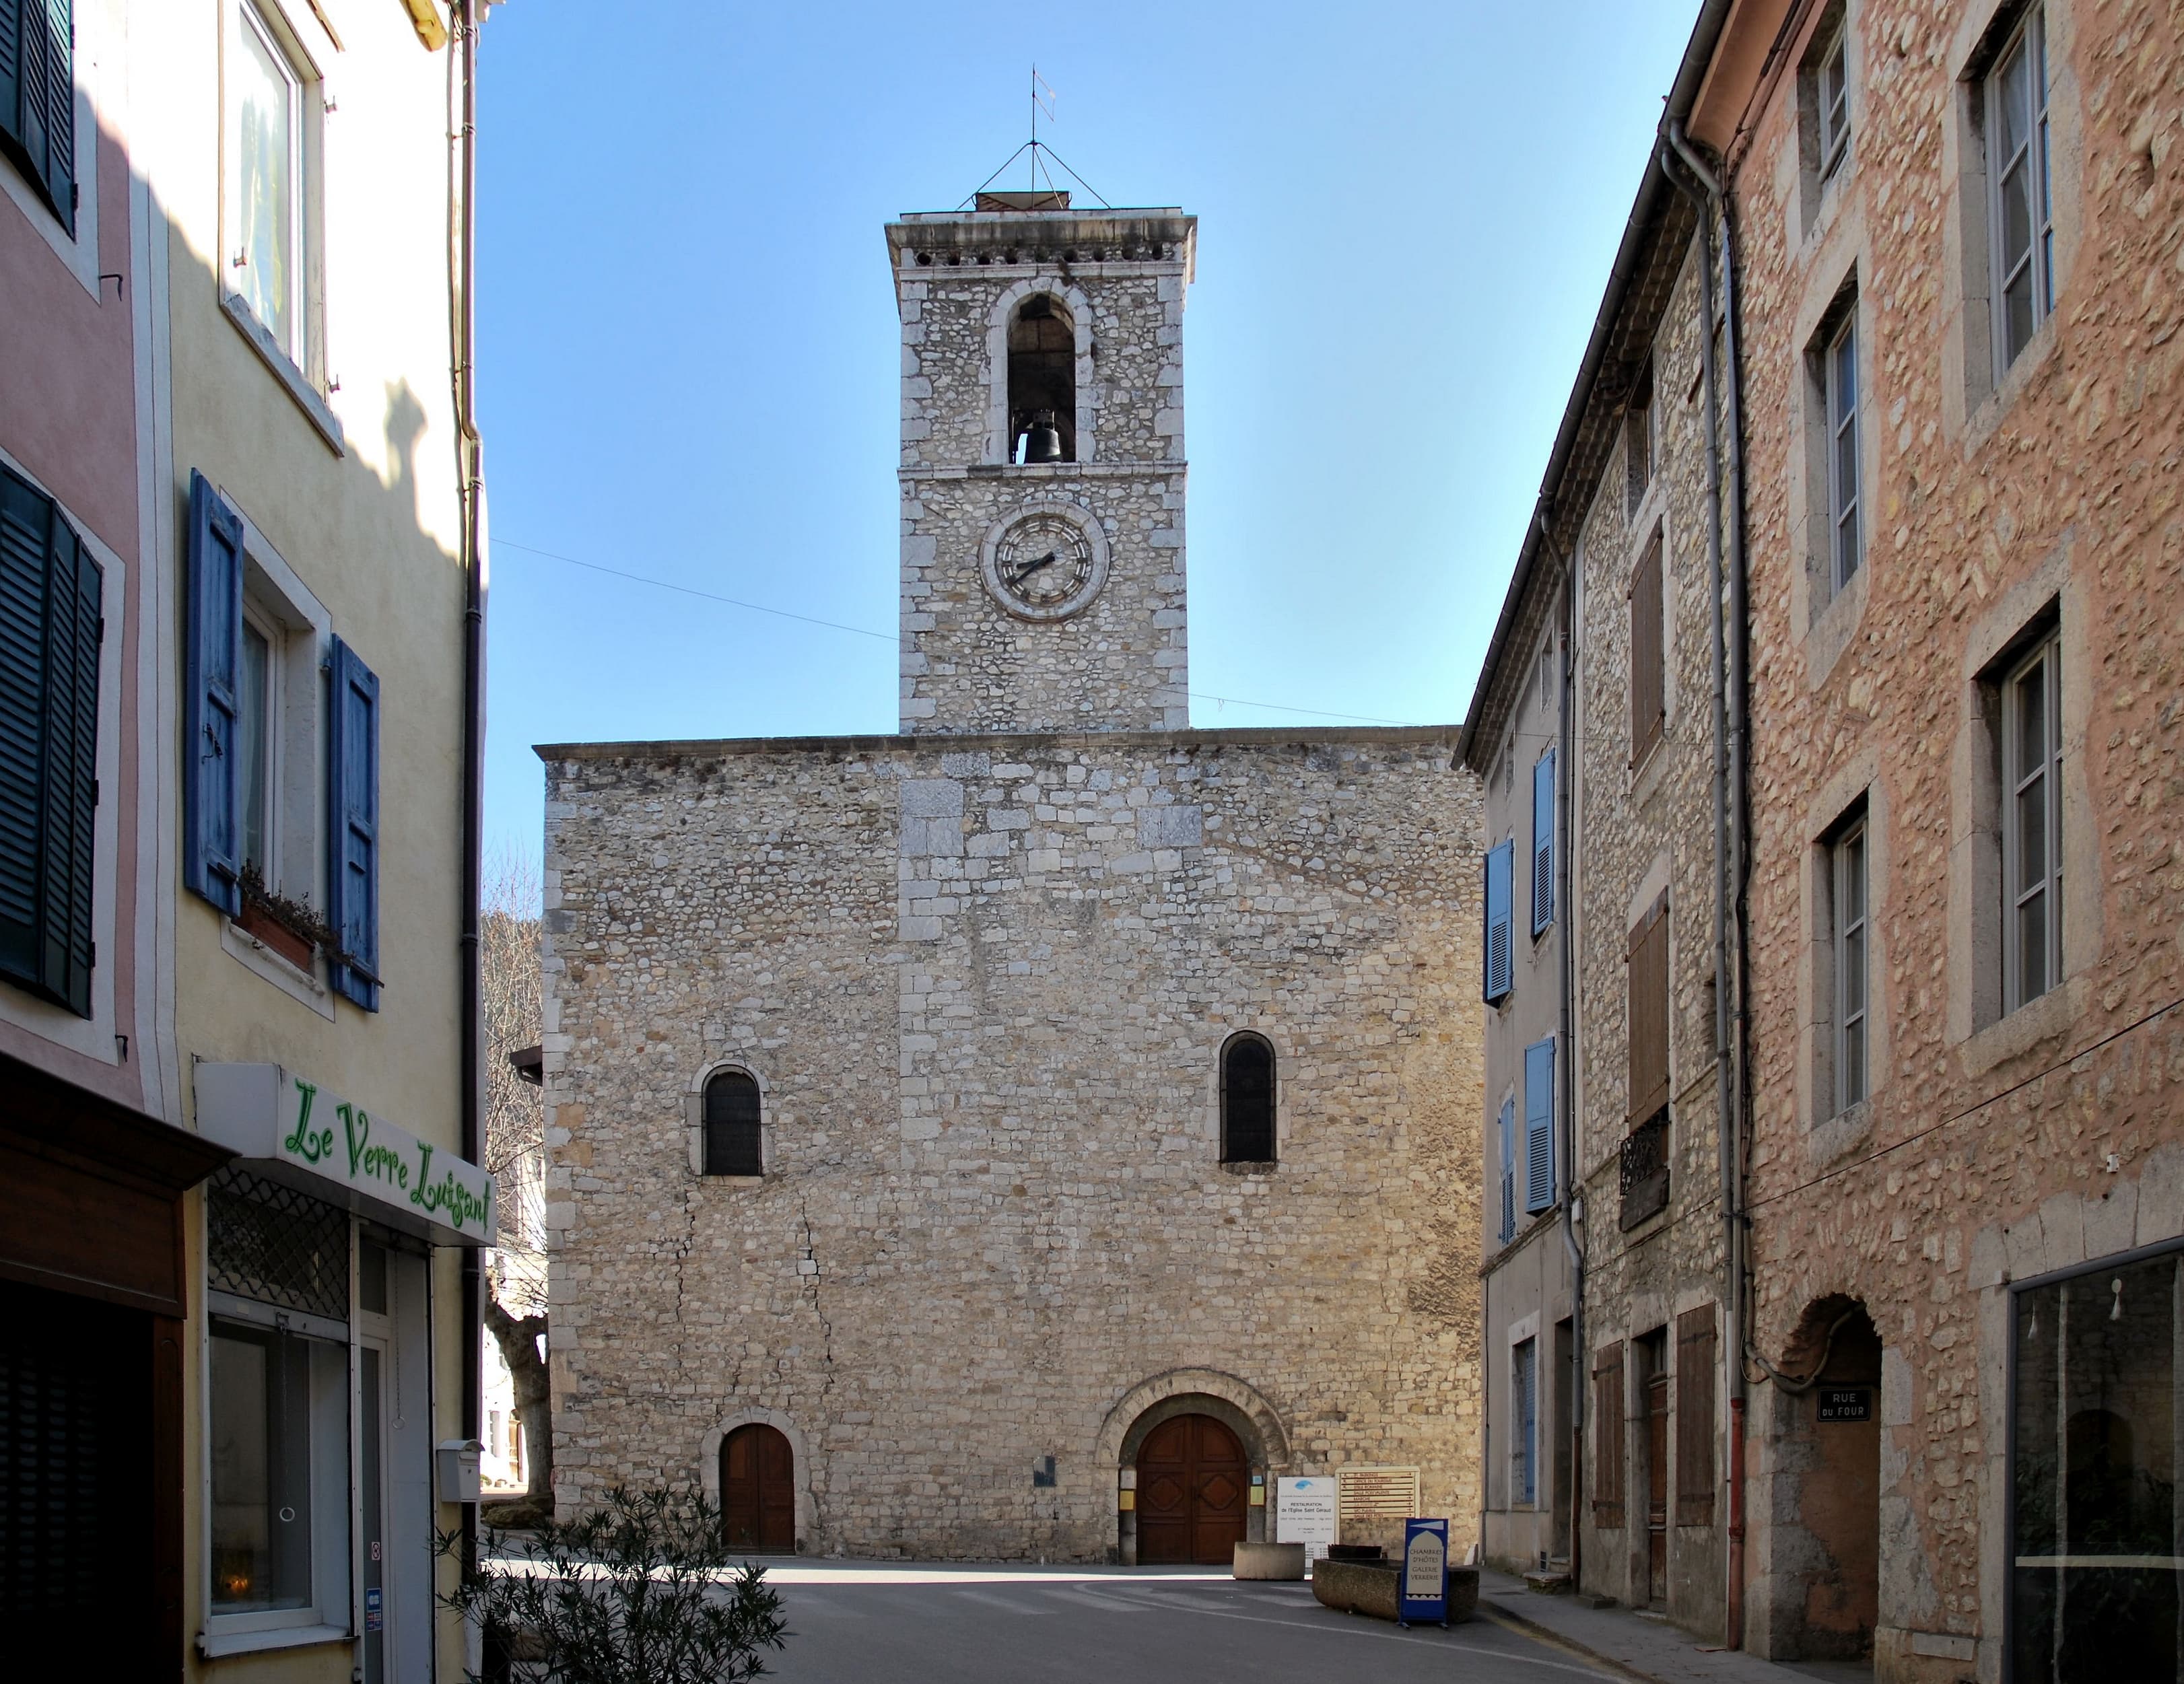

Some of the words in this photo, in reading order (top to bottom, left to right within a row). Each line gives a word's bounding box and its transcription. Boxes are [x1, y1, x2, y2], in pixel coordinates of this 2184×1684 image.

[284, 1077, 333, 1165] Le
[336, 1102, 408, 1190] Verre
[410, 1139, 491, 1236] Luisant
[1833, 1393, 1856, 1403] RUE
[1822, 1408, 1833, 1416] DU
[1838, 1406, 1864, 1416] FOUR
